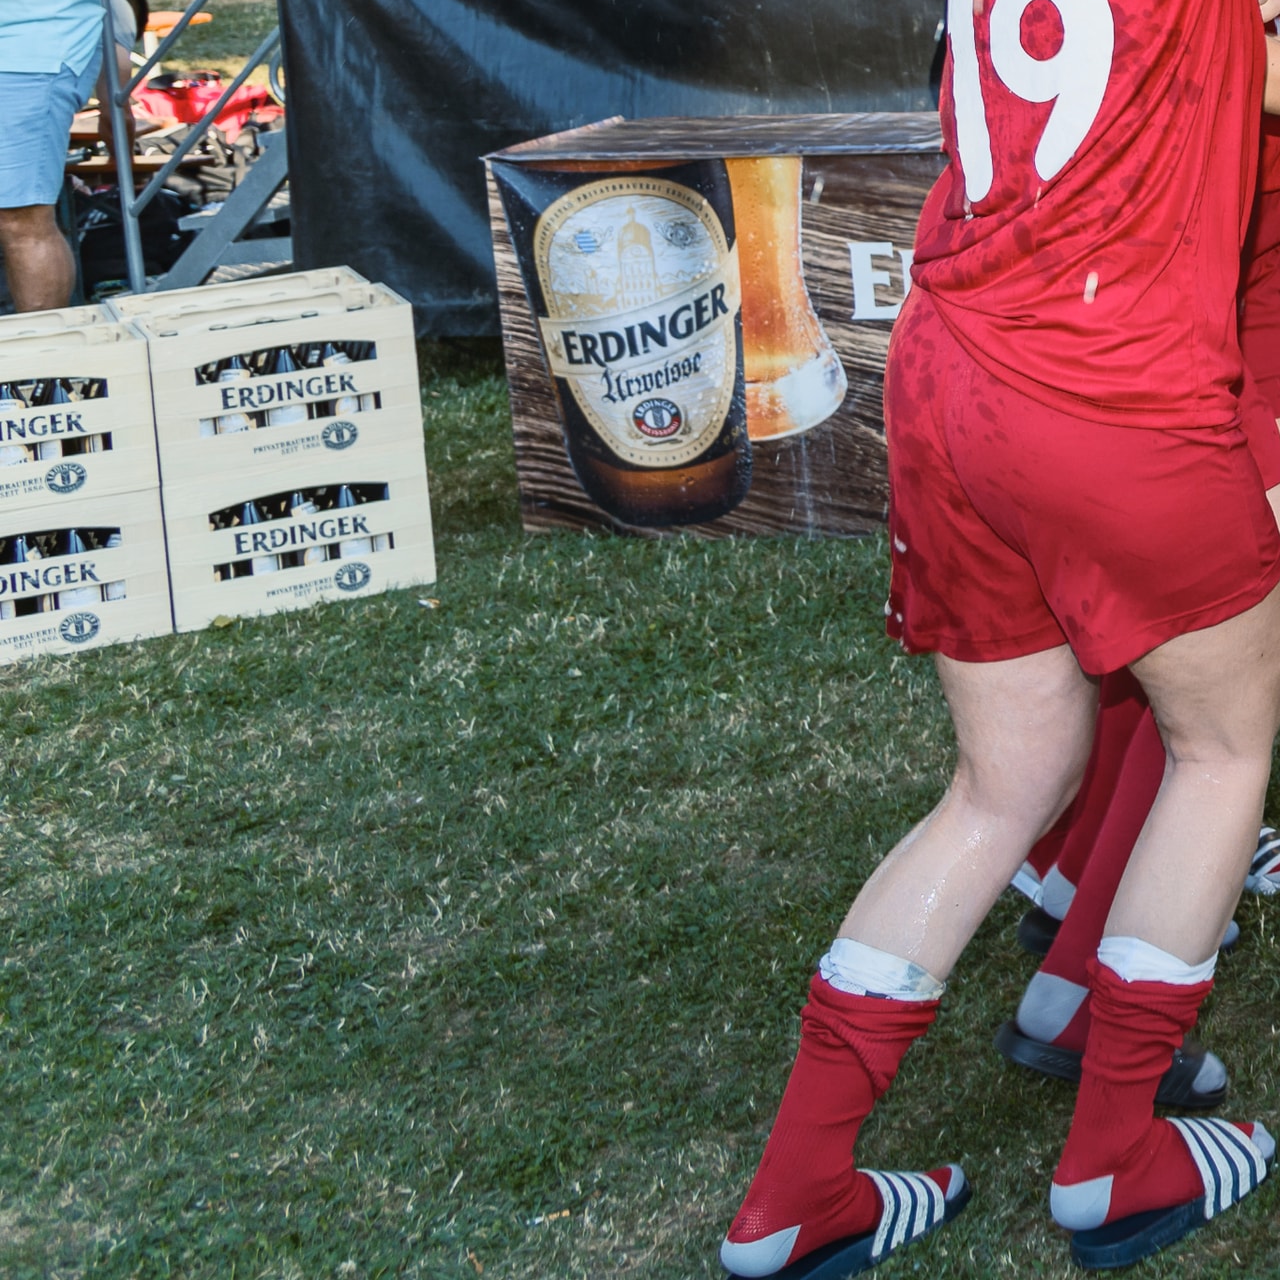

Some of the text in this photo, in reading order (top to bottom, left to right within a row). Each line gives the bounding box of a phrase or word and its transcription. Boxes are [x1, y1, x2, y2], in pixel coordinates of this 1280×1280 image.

[561, 282, 728, 368] ERDINGER
[221, 372, 359, 410] ERDINGER
[234, 514, 370, 555] ERDINGER
